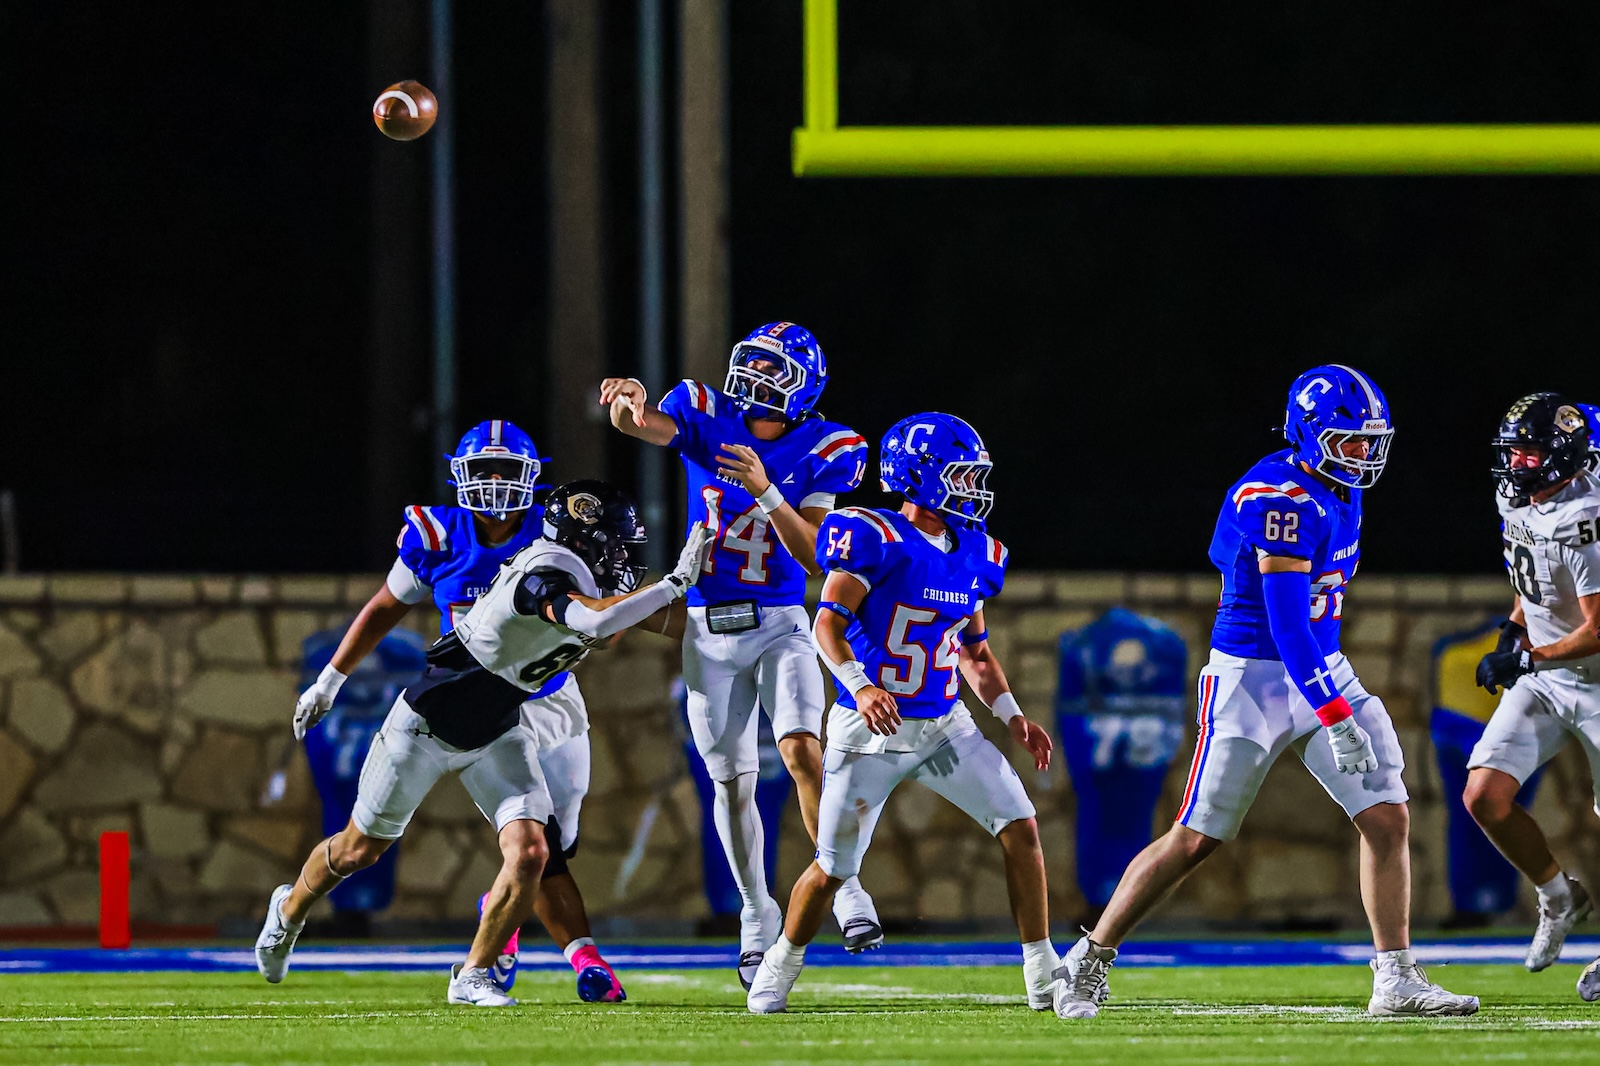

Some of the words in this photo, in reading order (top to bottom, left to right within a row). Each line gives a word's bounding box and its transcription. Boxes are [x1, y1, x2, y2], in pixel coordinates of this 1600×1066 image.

[757, 336, 781, 349] Riddell
[1296, 377, 1333, 411] C
[905, 423, 936, 455] C
[1365, 422, 1386, 430] Riddell
[702, 485, 771, 585] 14
[826, 526, 852, 560] 54
[1265, 510, 1299, 543] 62
[923, 587, 969, 605] CHILDRESS
[878, 602, 971, 699] 54
